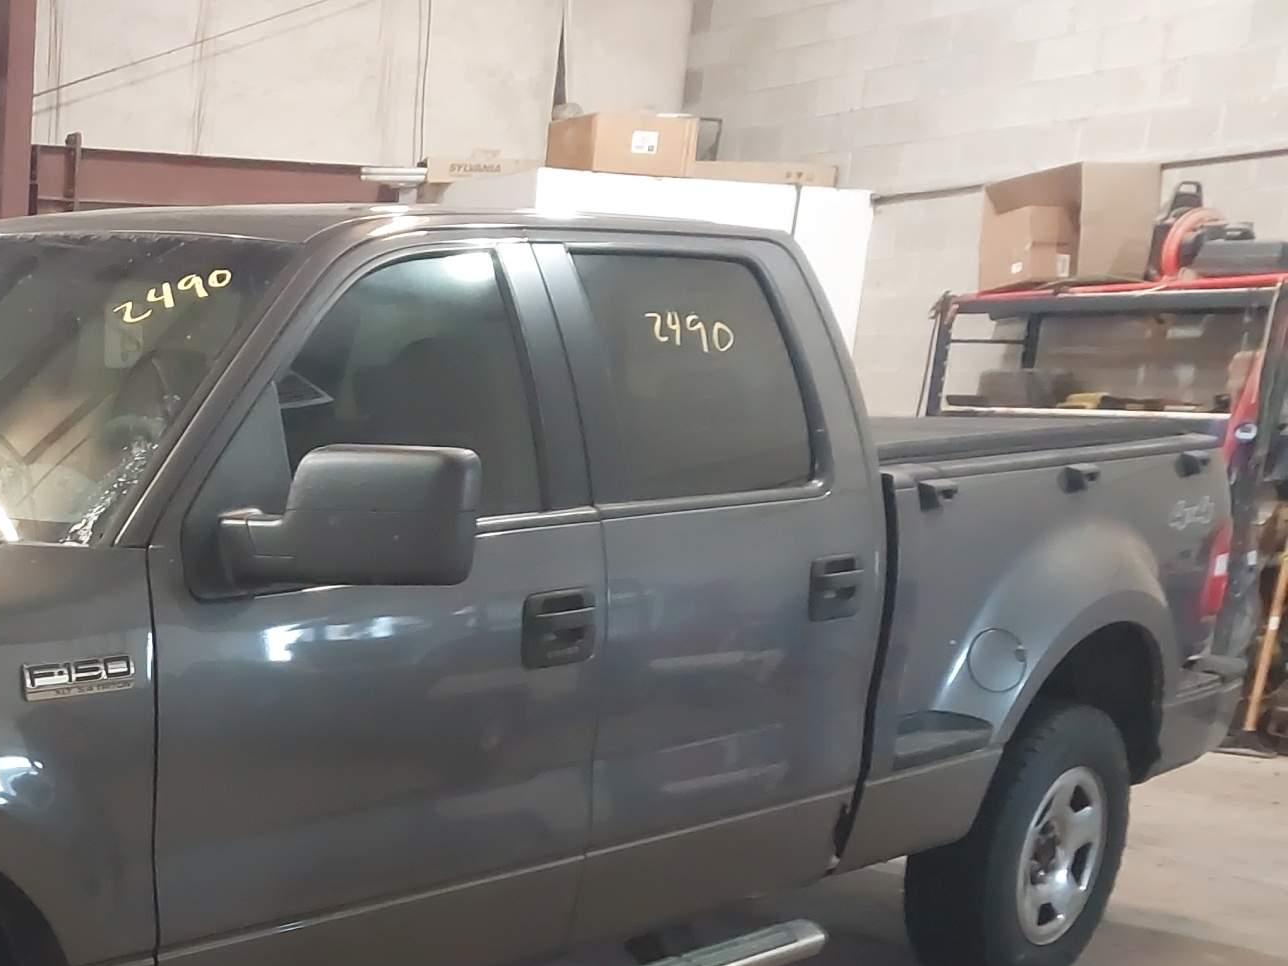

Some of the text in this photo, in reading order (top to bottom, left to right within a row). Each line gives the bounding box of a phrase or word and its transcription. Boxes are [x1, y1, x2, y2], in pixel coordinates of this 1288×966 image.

[448, 162, 502, 174] SYLVANIA
[112, 268, 232, 323] 2490
[643, 310, 734, 353] 2490
